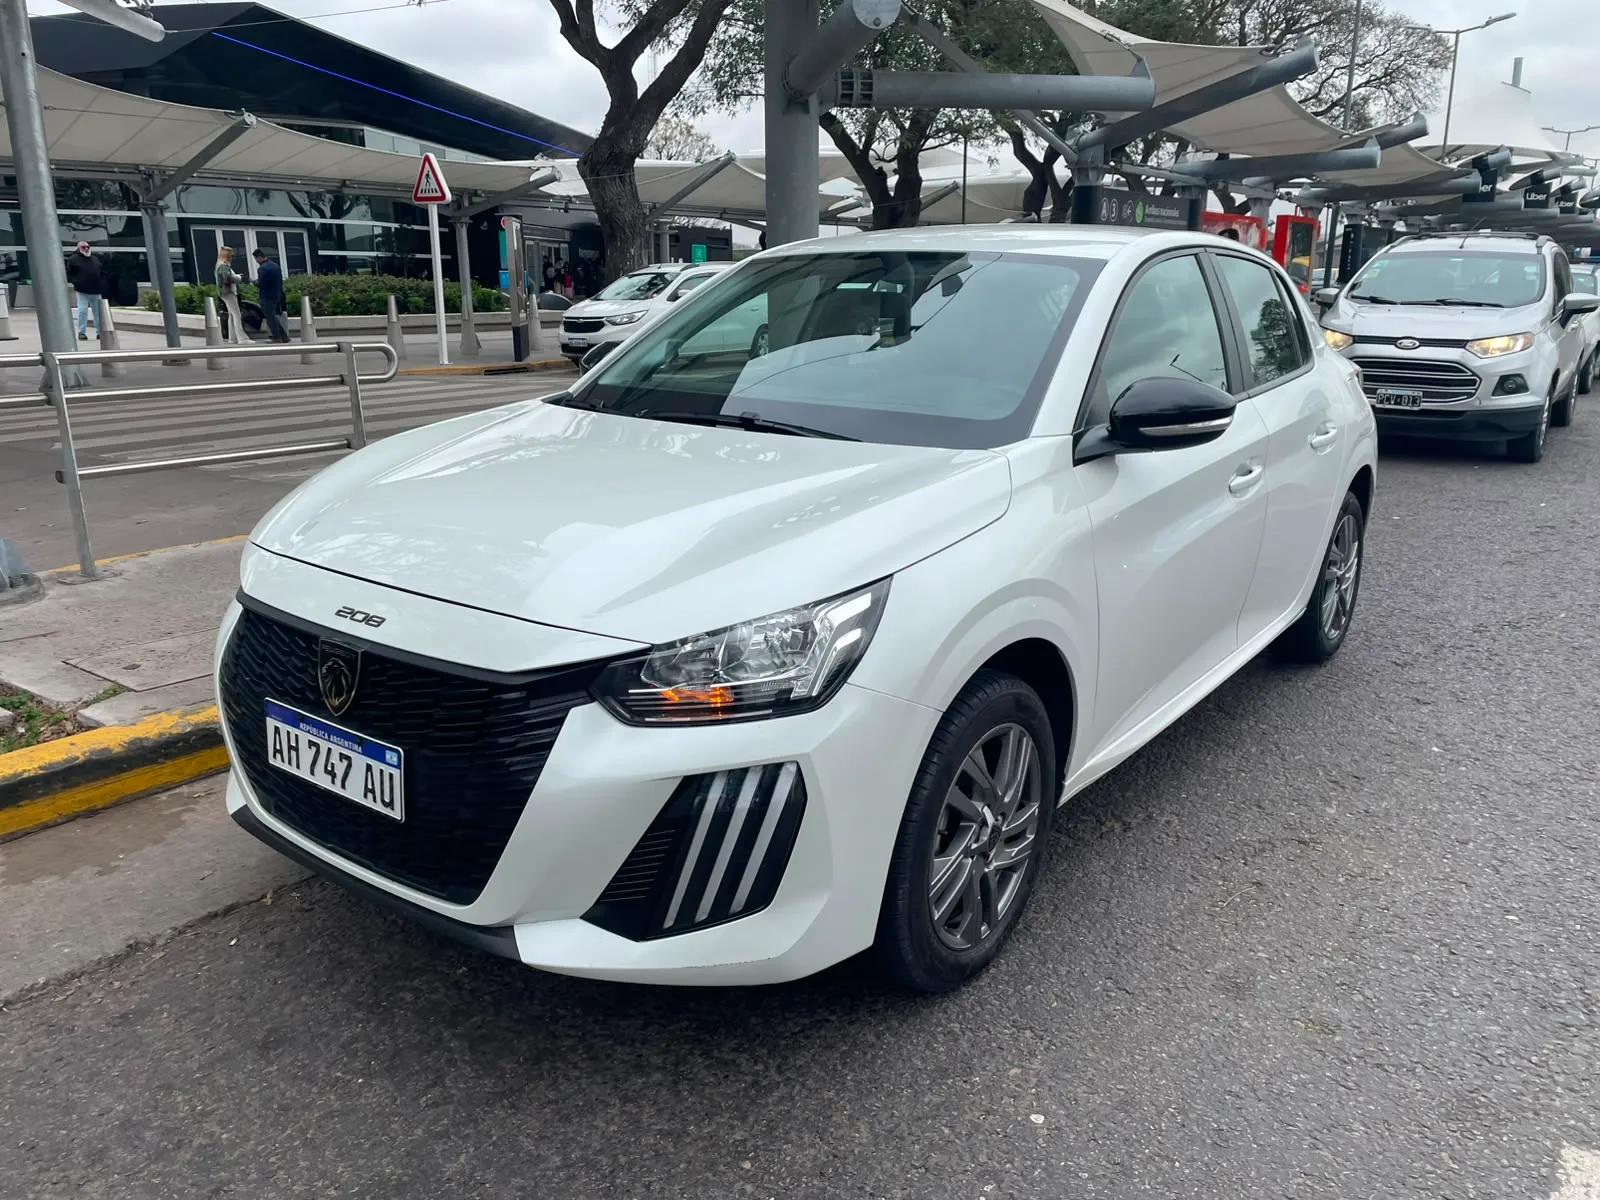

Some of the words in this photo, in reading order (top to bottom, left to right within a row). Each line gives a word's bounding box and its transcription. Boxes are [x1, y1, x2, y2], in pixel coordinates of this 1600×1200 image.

[1526, 192, 1547, 201] Uber
[1377, 394, 1395, 405] PCV
[1401, 395, 1421, 407] 013
[335, 605, 387, 628] 208
[300, 722, 329, 740] REPÚBLICA
[330, 735, 363, 754] ARGENTINA
[273, 724, 301, 770] AH
[307, 738, 353, 790] 747
[363, 762, 395, 811] AU
